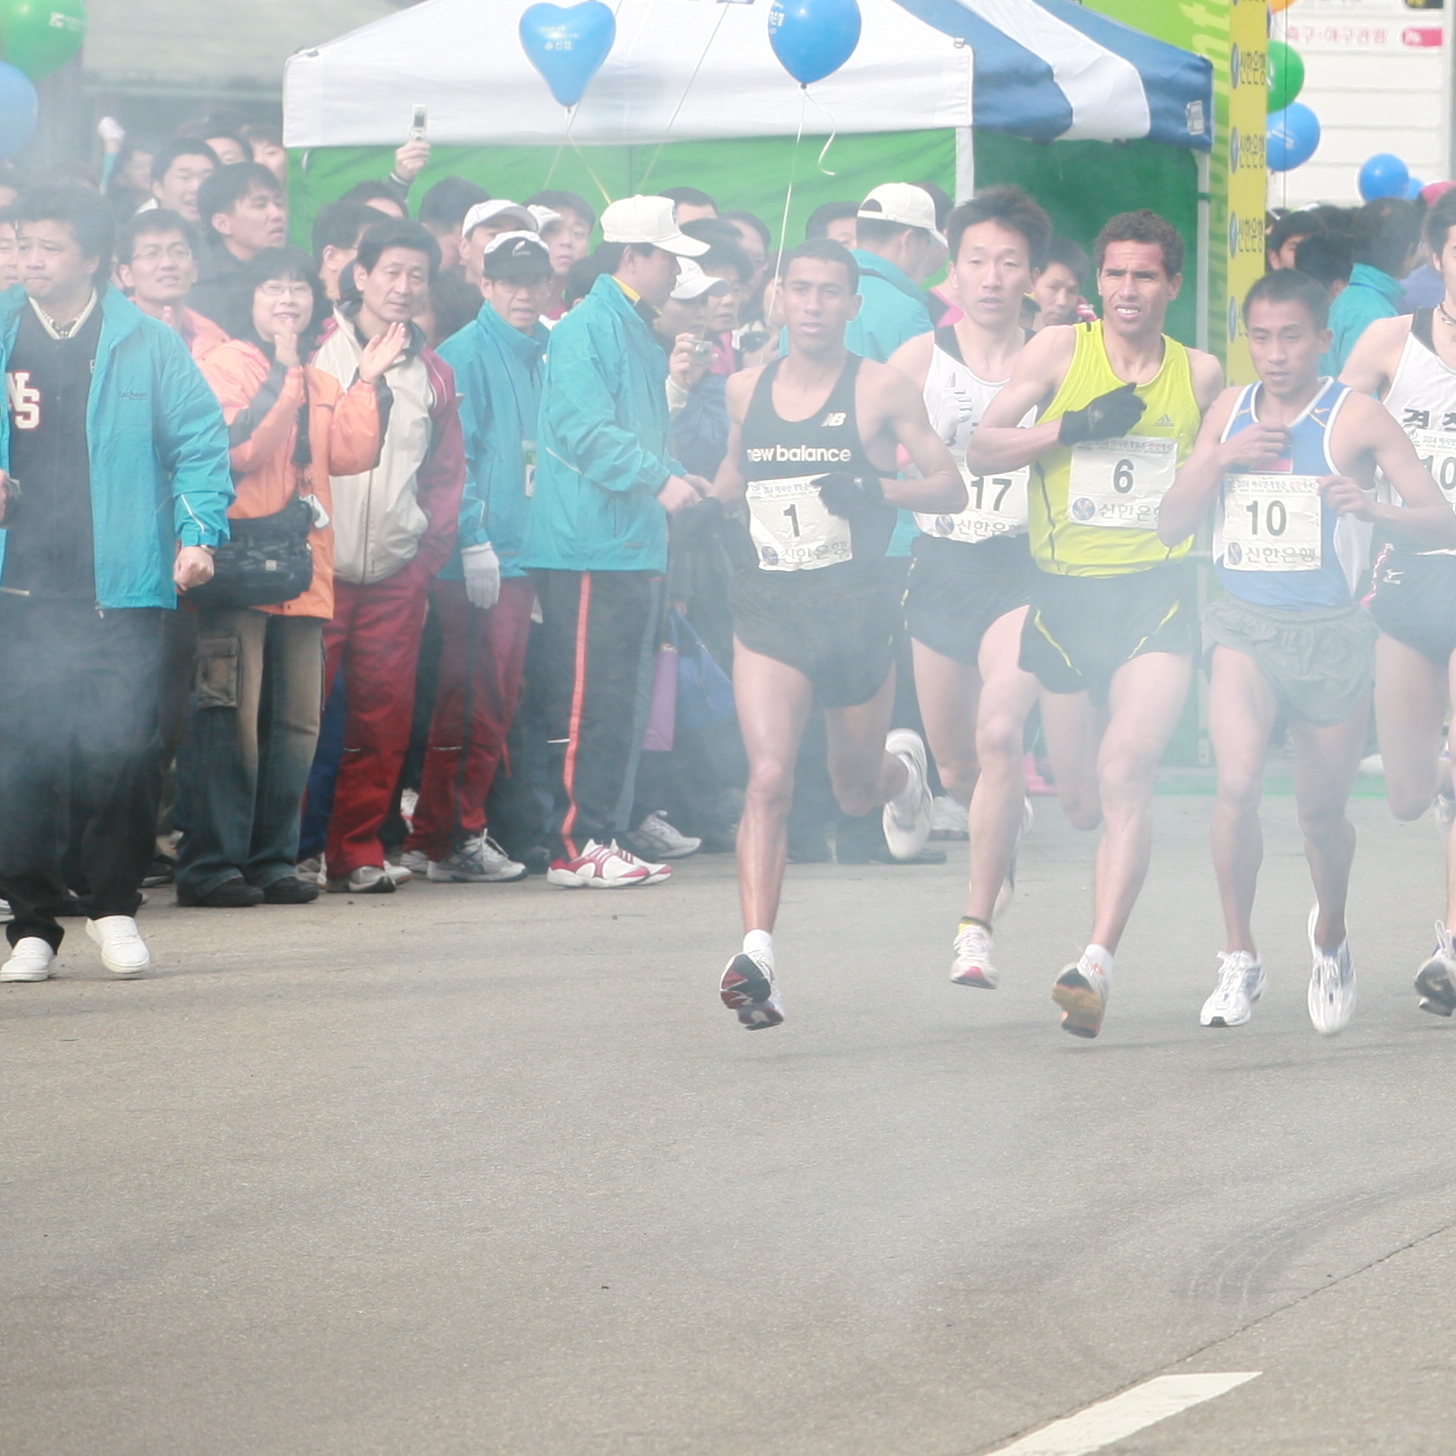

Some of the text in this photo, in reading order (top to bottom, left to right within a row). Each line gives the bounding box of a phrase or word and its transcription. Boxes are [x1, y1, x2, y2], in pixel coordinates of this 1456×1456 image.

[1113, 459, 1134, 494] 6
[783, 504, 800, 538] 1
[1246, 500, 1286, 536] 10
[1245, 547, 1316, 564] 신한은행
